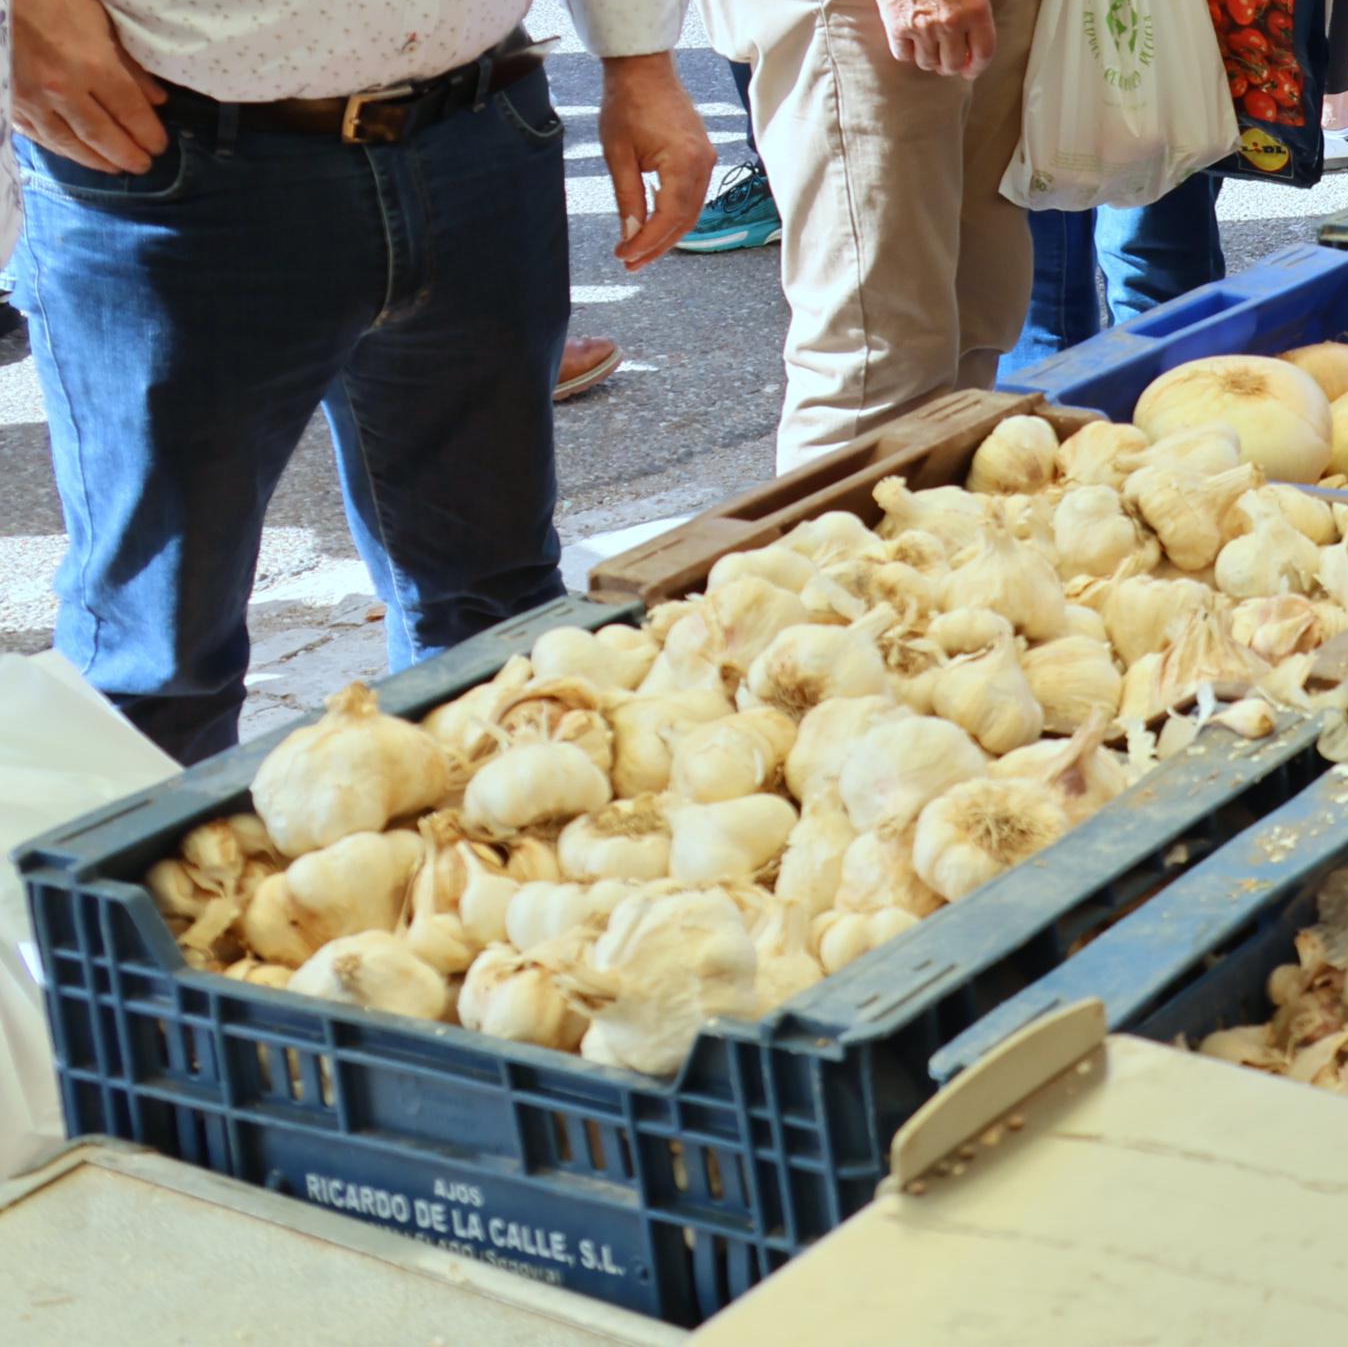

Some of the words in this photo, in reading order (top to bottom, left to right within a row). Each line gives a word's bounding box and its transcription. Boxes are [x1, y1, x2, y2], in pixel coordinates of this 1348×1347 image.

[304, 1173, 411, 1223] RICARDO
[415, 1201, 449, 1233] DE
[452, 1209, 485, 1242] LA
[488, 1219, 577, 1266] CALLE,
[579, 1239, 627, 1276] S.L.
[433, 1179, 484, 1208] AJOS
